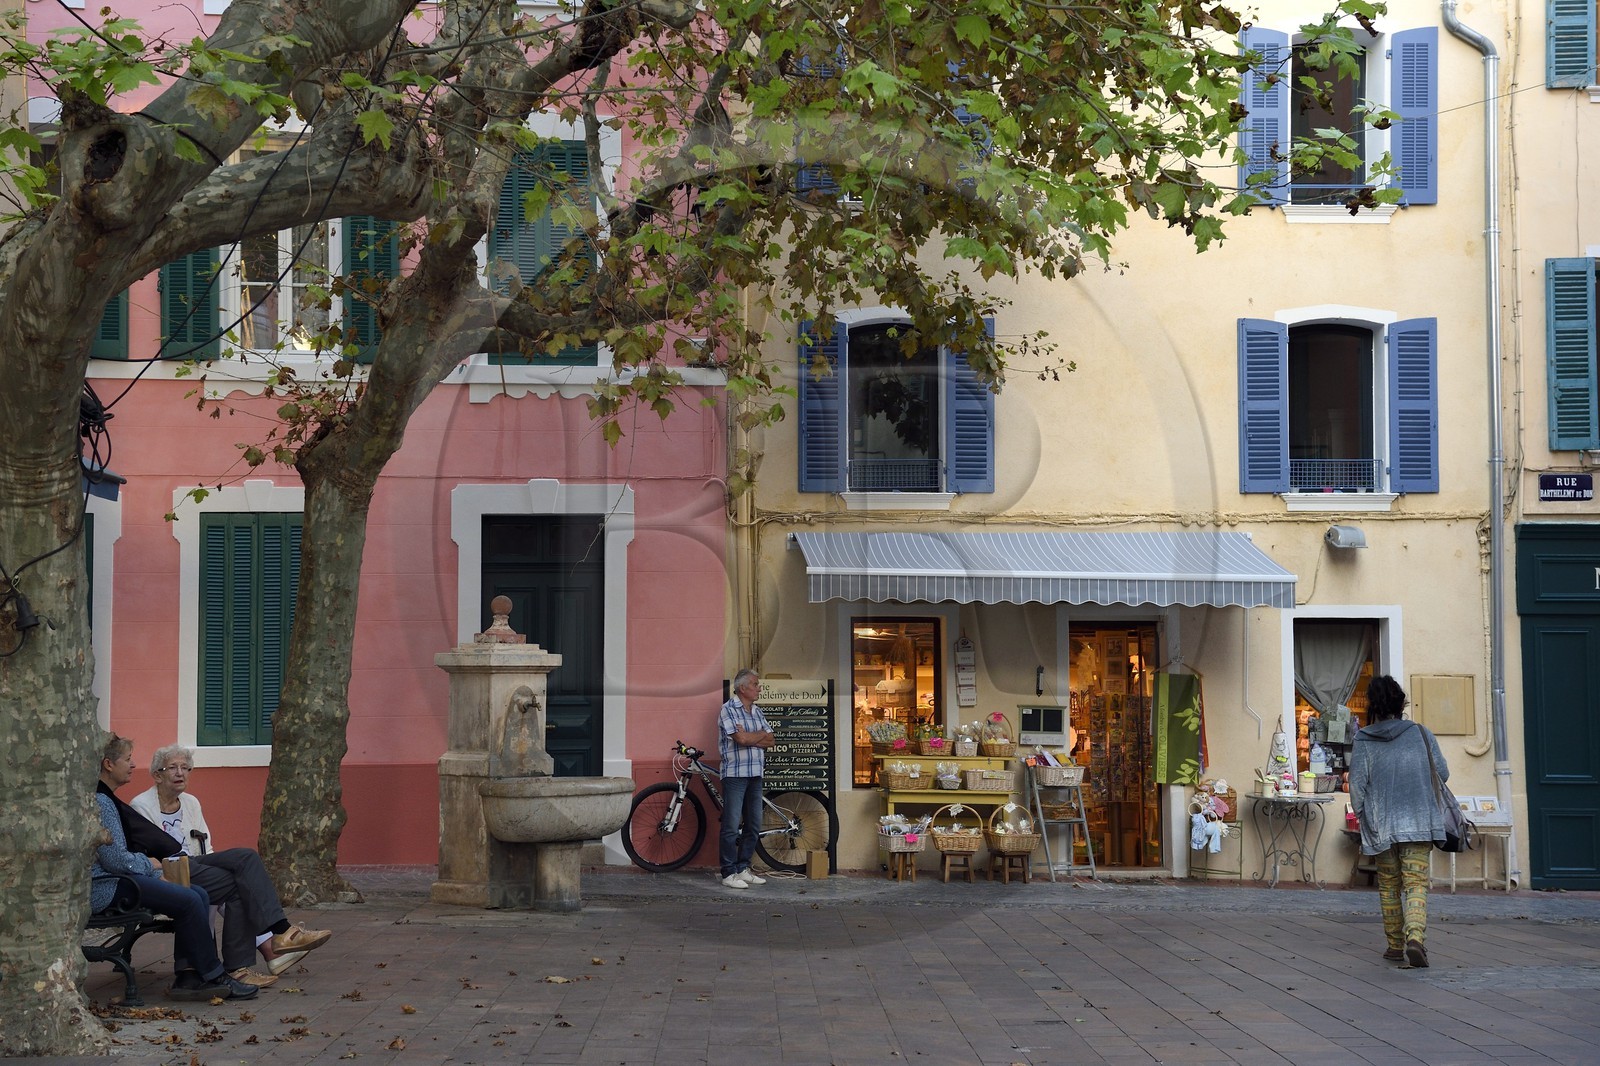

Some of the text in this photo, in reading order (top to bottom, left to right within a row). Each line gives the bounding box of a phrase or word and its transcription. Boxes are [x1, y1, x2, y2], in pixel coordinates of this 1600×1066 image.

[1556, 477, 1577, 486] RUE
[1540, 489, 1575, 498] BARTHELEMY
[759, 682, 770, 691] rie
[758, 691, 820, 701] hélémy de Don
[767, 720, 782, 729] ops
[766, 744, 788, 753] MICO
[791, 756, 820, 764] Temps
[1158, 735, 1167, 778] OLIVIERS
